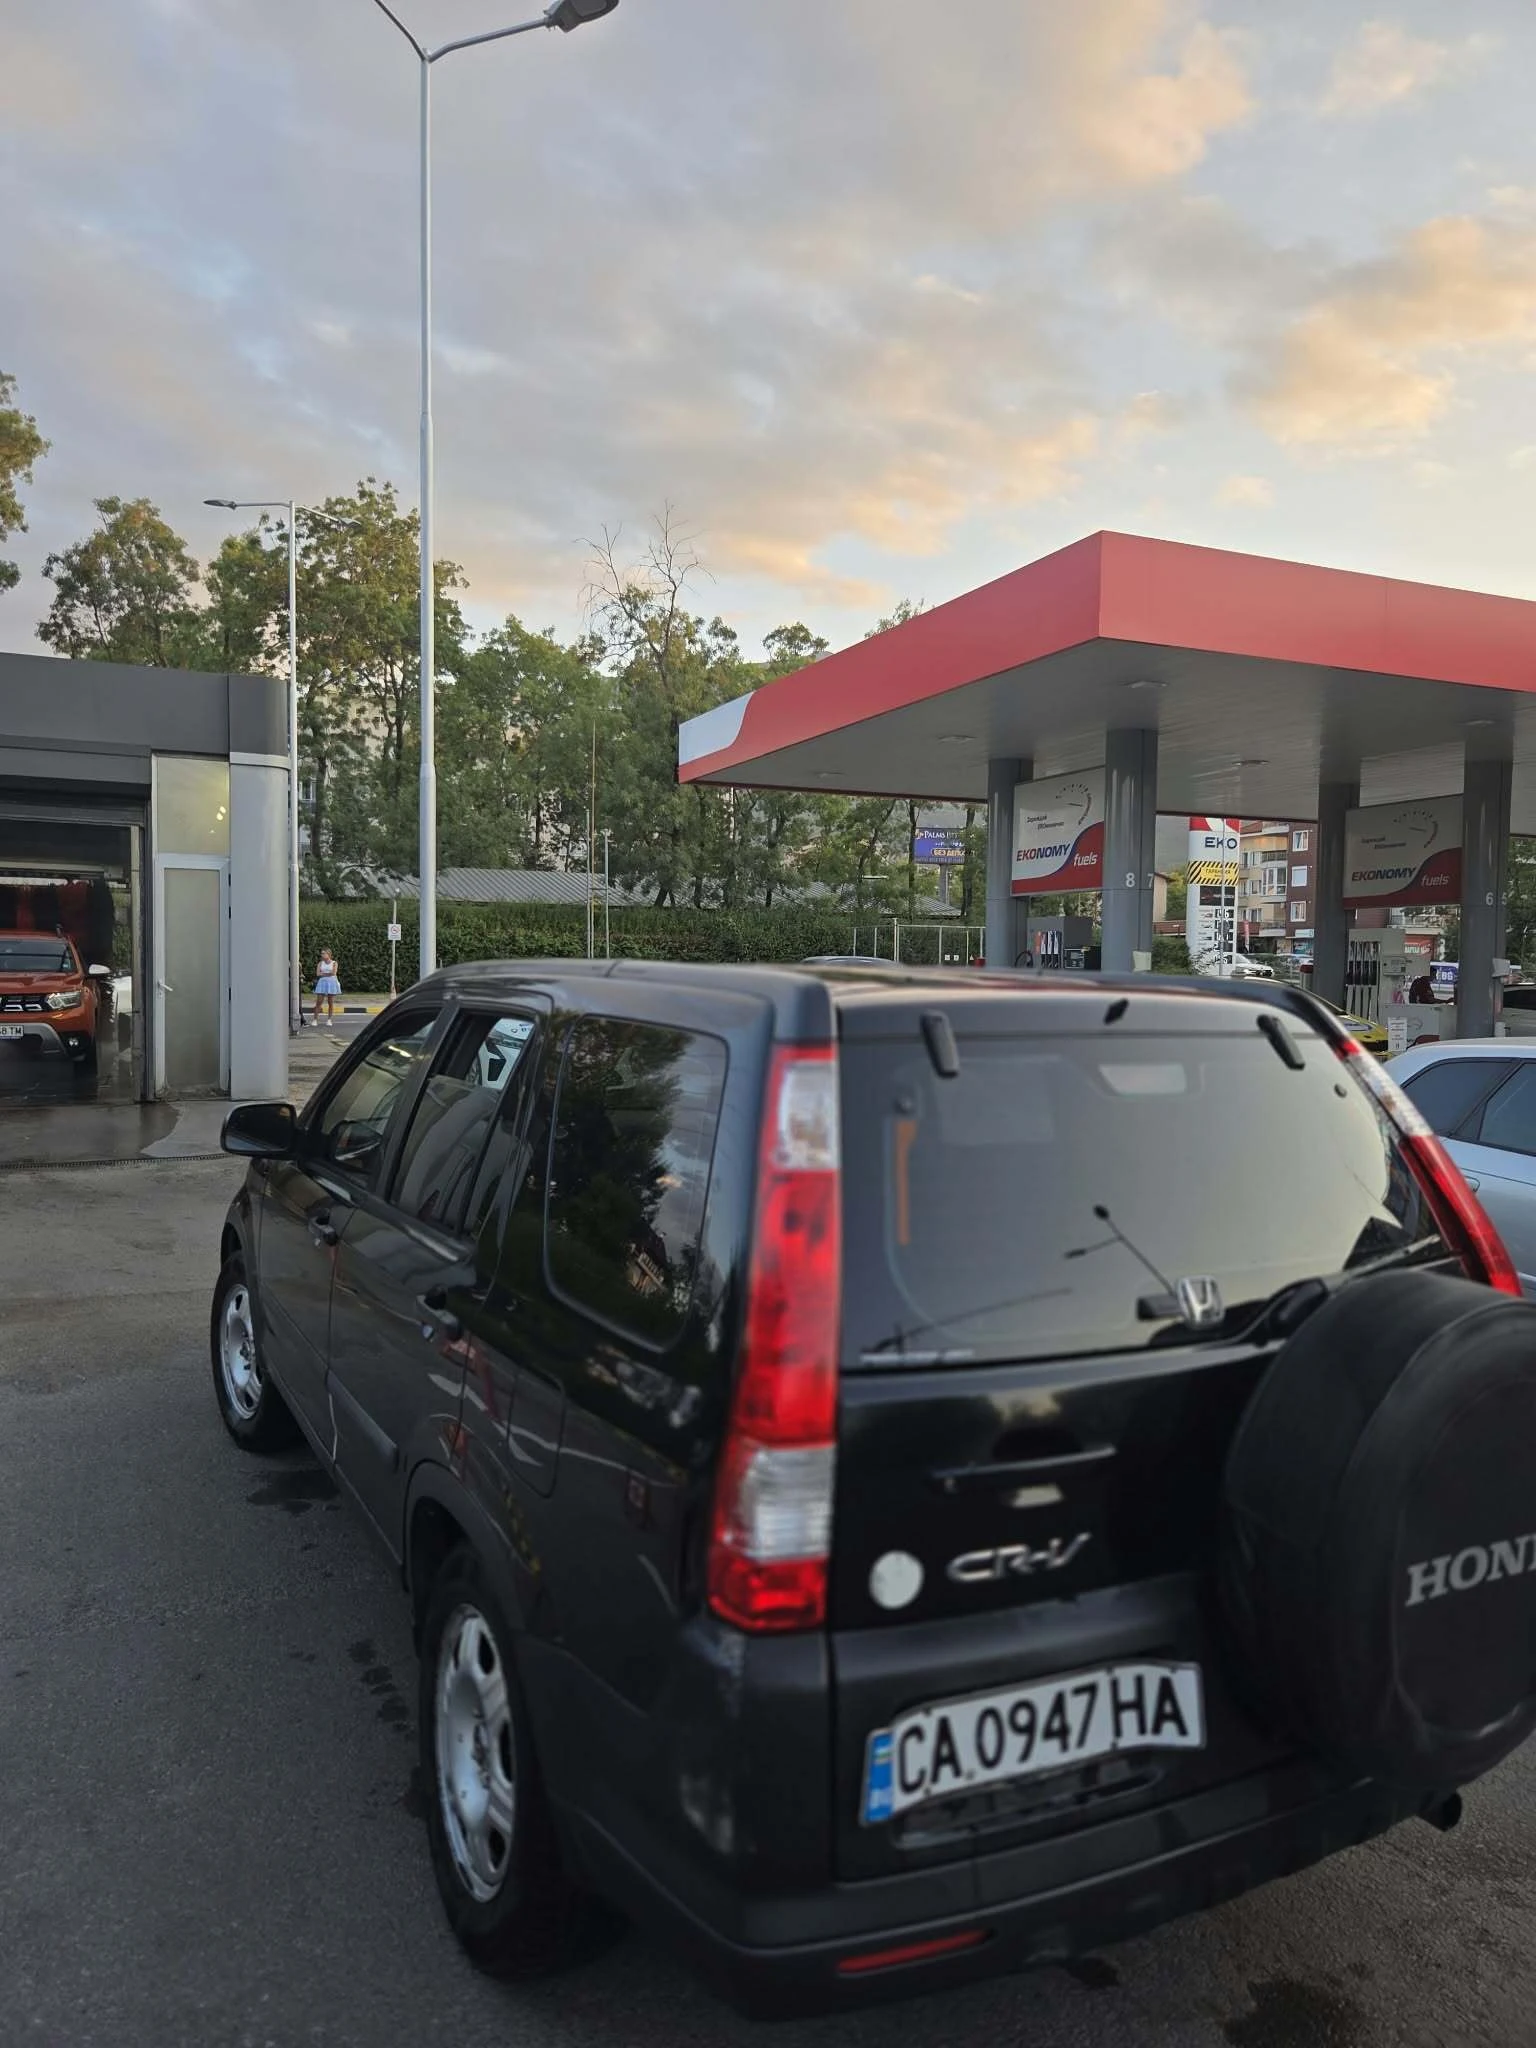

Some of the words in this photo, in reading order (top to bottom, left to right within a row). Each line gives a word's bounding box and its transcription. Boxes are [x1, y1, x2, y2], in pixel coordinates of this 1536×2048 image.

[1205, 836, 1238, 850] EKO
[1016, 843, 1070, 862] EKONOMY
[1073, 851, 1098, 867] fuels
[1125, 872, 1136, 888] 8
[1147, 873, 1154, 888] 7
[1351, 866, 1417, 882] EKONOMY
[1421, 873, 1450, 888] fuels
[1485, 892, 1494, 906] 6
[947, 1531, 1092, 1582] CR-V
[897, 1716, 963, 1794] CA
[976, 1682, 1099, 1770] 0947
[1110, 1674, 1189, 1738] HA
